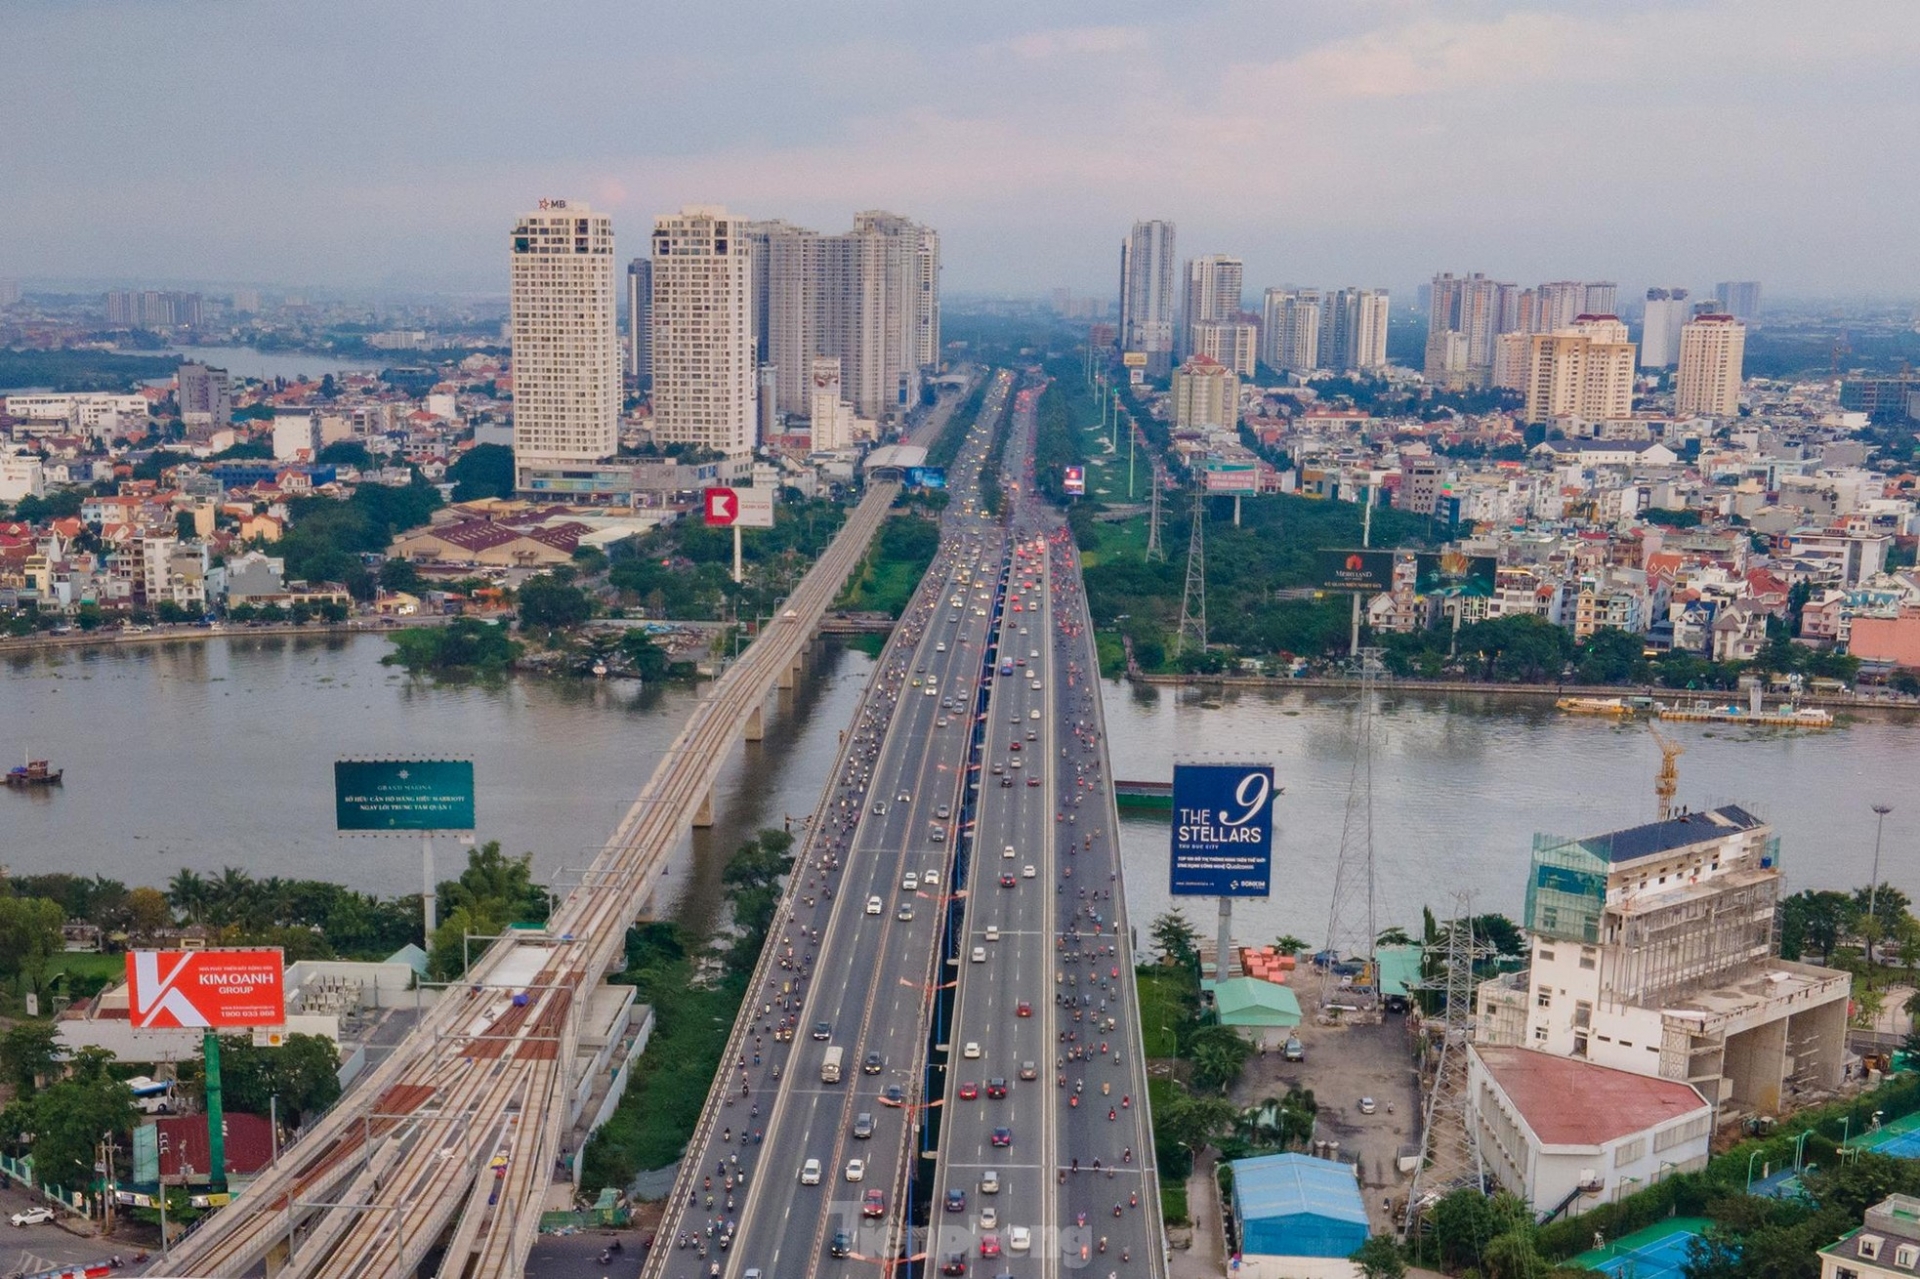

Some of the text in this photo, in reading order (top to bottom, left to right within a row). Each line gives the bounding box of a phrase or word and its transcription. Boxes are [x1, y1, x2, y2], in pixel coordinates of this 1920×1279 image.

[551, 199, 566, 209] MB
[1219, 772, 1269, 826] 9
[1179, 808, 1210, 825] THE
[1178, 826, 1261, 843] STELLARS
[199, 973, 274, 985] KIM OANH
[218, 986, 254, 995] GROUP
